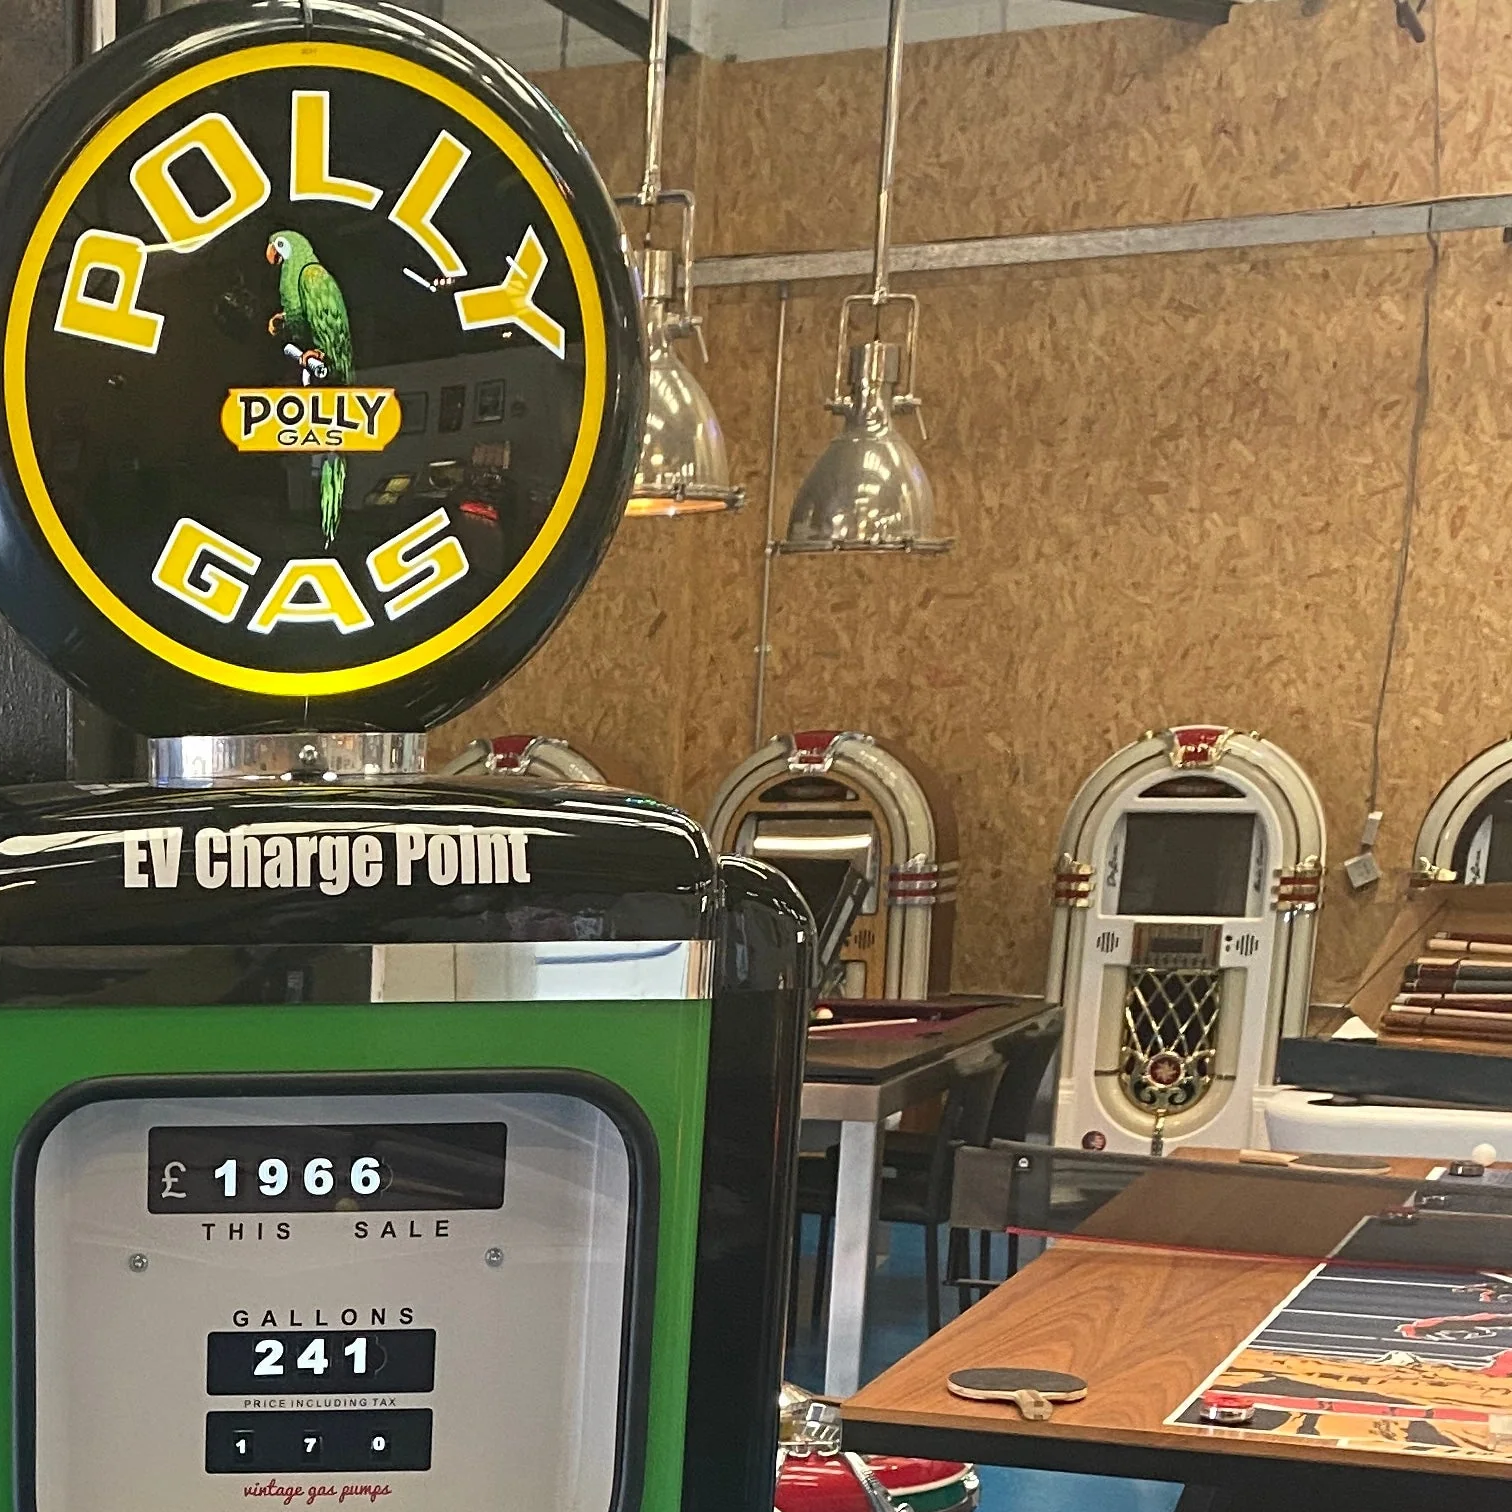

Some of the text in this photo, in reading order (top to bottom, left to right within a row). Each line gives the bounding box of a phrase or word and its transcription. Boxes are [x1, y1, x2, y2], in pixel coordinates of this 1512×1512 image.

[54, 89, 566, 361] POLLY
[239, 395, 387, 437] POLLY
[277, 429, 344, 447] GAS
[152, 506, 469, 635] GAS
[124, 825, 531, 896] EV Charge Point
[161, 1157, 381, 1199] £ 1966
[202, 1219, 450, 1241] THIS SALE
[232, 1307, 414, 1328] GALLONS
[253, 1337, 368, 1376] 241
[244, 1397, 397, 1409] PRICE INCLUDING TAX
[244, 1479, 392, 1506] vintage gas pumps
